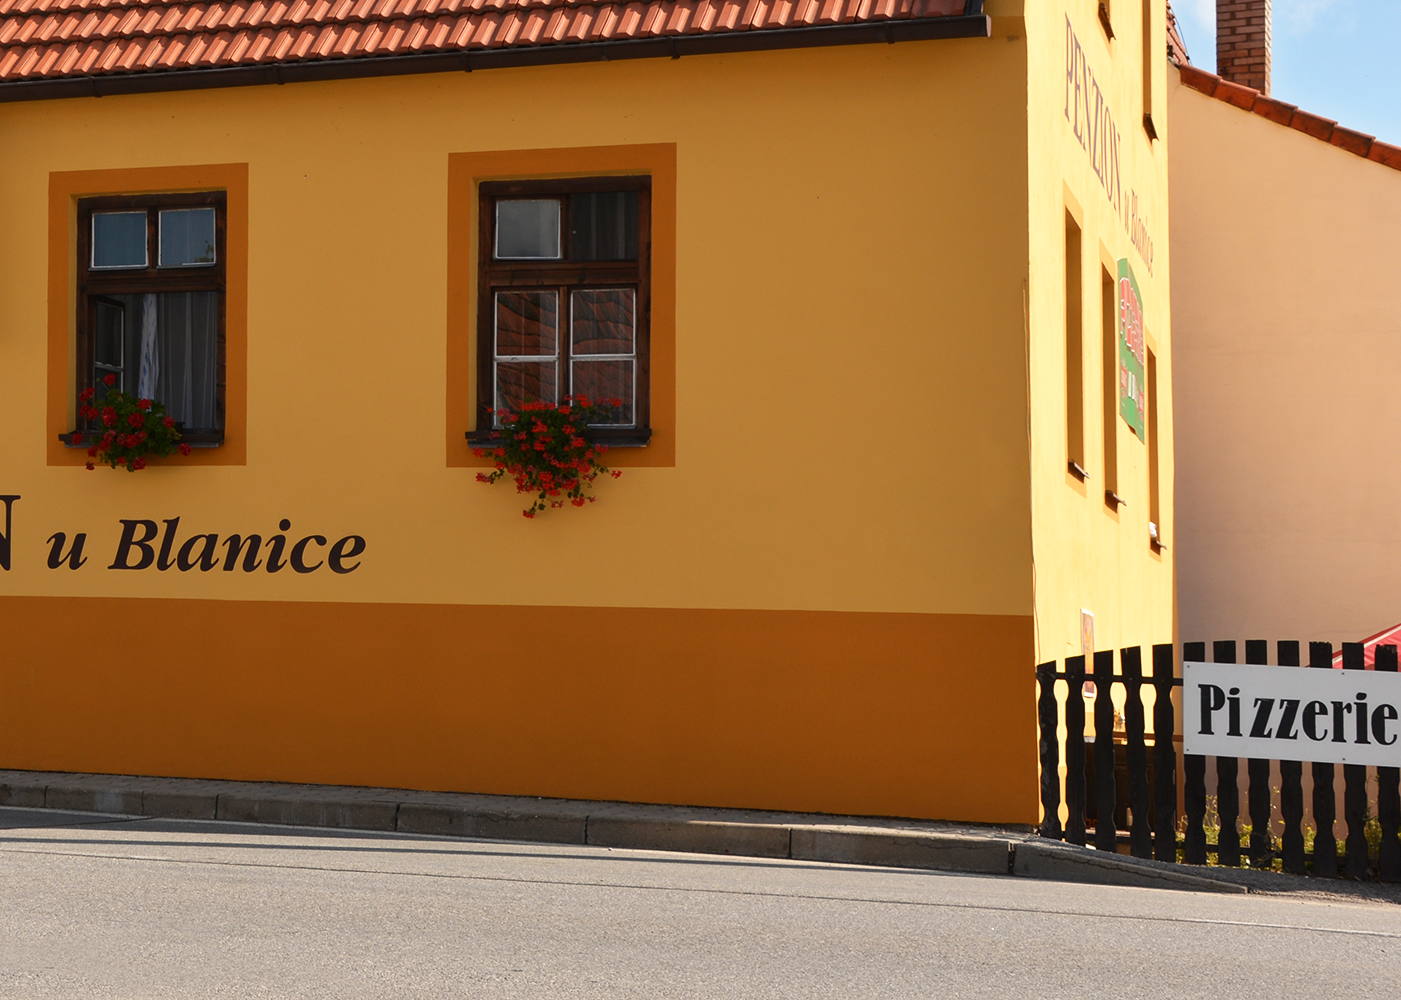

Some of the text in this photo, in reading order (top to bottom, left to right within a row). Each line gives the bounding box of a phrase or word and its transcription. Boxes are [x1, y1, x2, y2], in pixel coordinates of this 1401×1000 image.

[1064, 10, 1121, 223] PENZION
[46, 531, 88, 571] u
[107, 516, 367, 574] Blanice
[1197, 683, 1399, 746] Pizzerie
